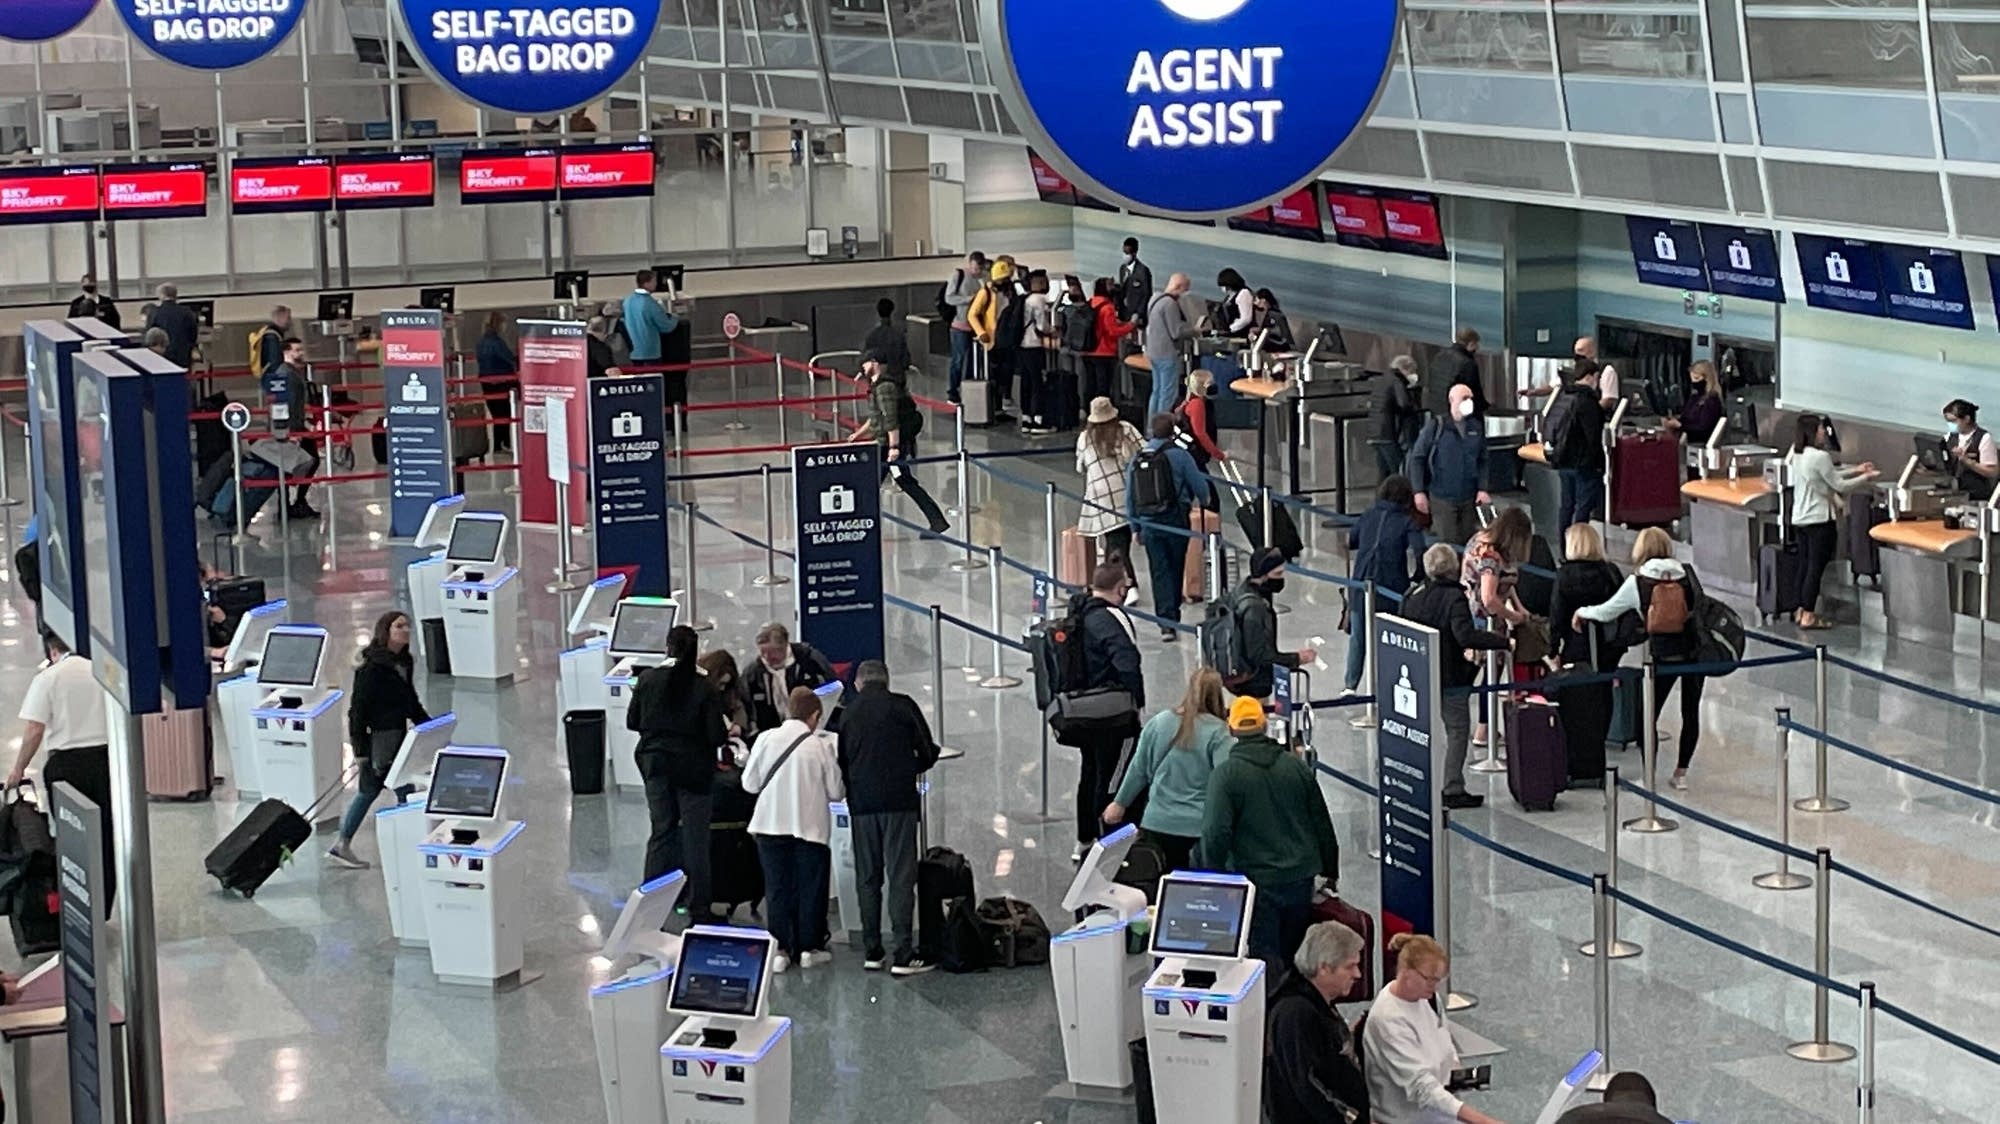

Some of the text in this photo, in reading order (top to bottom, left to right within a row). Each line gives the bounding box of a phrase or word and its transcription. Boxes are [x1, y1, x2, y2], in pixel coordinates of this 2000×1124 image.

[153, 16, 275, 41] BAG DROP
[432, 8, 634, 39] SELF-TAGGED
[456, 42, 614, 73] BAG DROP
[1127, 47, 1283, 93] AGENT
[1127, 100, 1283, 148] ASSIST
[396, 317, 427, 325] DELTA
[609, 385, 644, 394] DELTA
[597, 441, 659, 454] SELF-TAGGED
[605, 451, 653, 463] BAG DROP
[817, 454, 857, 465] DELTA
[803, 519, 874, 534] SELF-TAGGED
[812, 530, 867, 544] BAG DROP
[1390, 631, 1418, 653] DELTA
